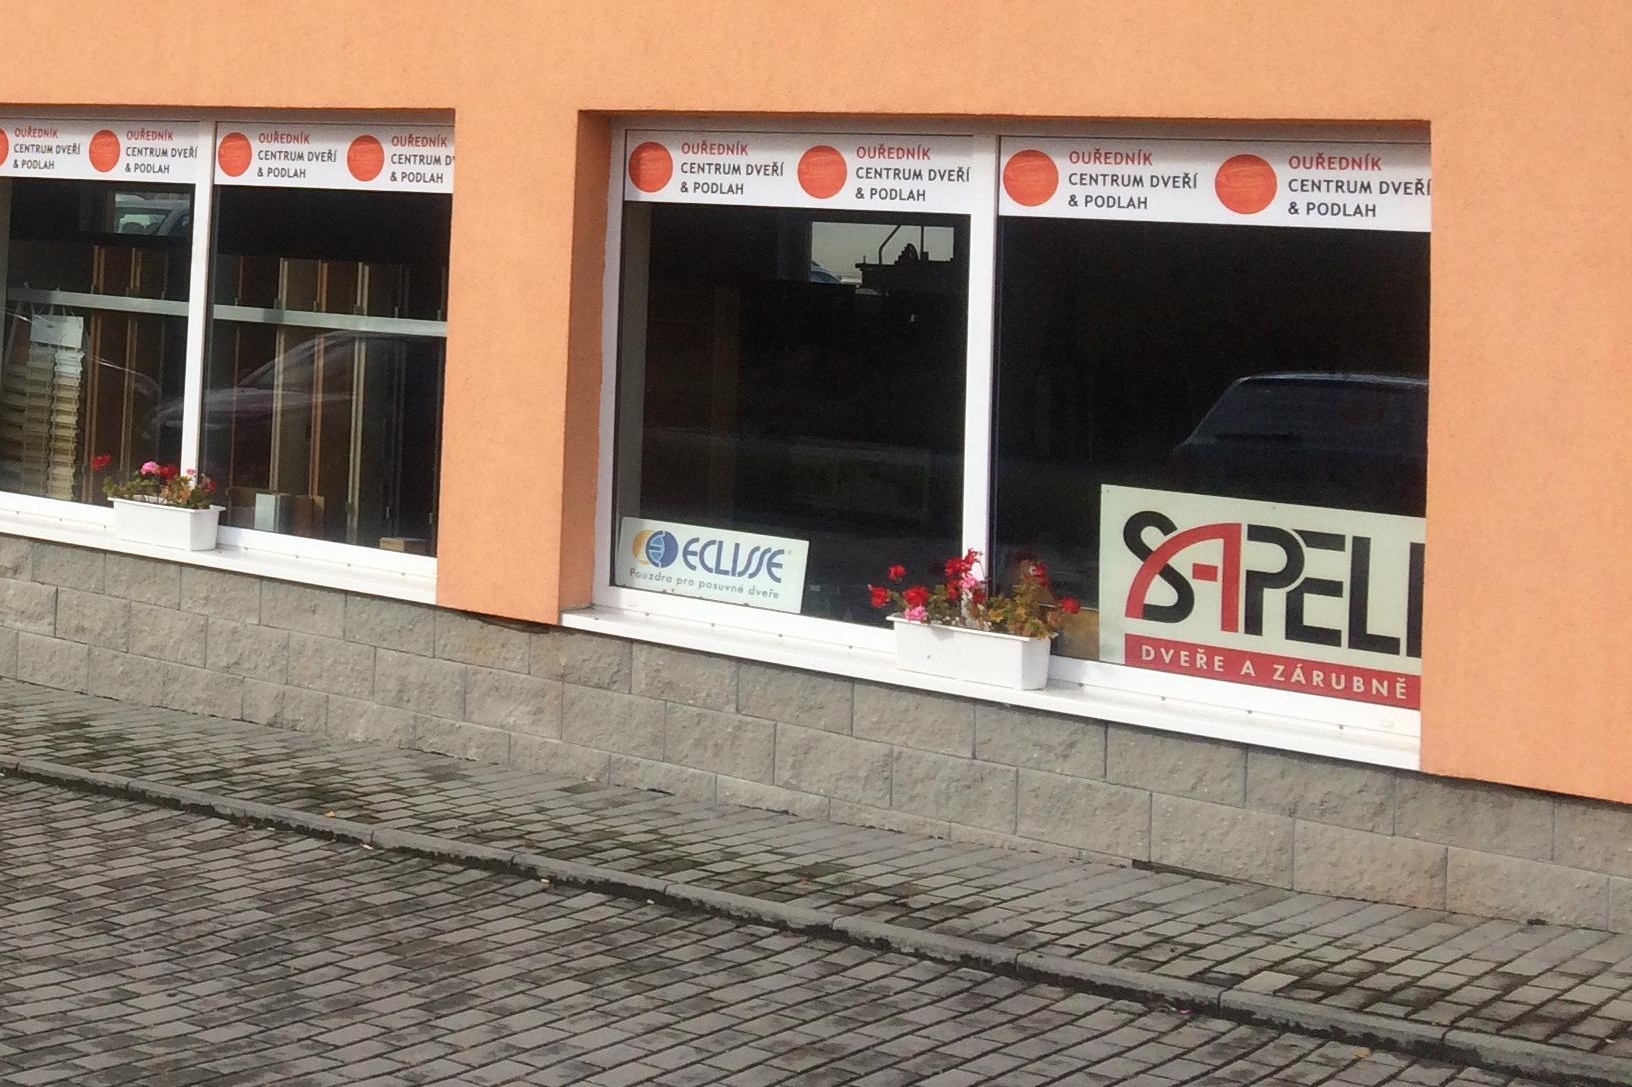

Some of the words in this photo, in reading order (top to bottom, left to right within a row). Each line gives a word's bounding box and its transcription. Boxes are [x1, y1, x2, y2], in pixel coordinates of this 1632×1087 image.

[13, 126, 59, 140] OUŘEDNÍK
[126, 127, 174, 142] OUŘEDNÍK
[258, 130, 311, 146] OUŘEDNÍK
[391, 132, 448, 150] OUŘEDNÍK
[13, 142, 54, 155] CENTRUM
[55, 142, 81, 156] DVEŘÍ
[125, 146, 168, 158] CENTRUM
[170, 145, 198, 160] DVEŘÍ
[257, 149, 305, 163] CENTRUM
[307, 148, 337, 164] DVEŘÍ
[680, 140, 748, 156] OUŘEDNÍK
[856, 144, 931, 161] OUŘEDNÍK
[13, 159, 19, 169] &
[21, 159, 55, 170] PODLAH
[390, 153, 441, 166] CENTRUM
[1068, 148, 1153, 167] OUŘEDNÍK
[1288, 152, 1383, 172] OUŘEDNÍK
[125, 162, 132, 173] &
[134, 162, 170, 175] PODLAH
[256, 166, 264, 178] &
[266, 167, 306, 179] PODLAH
[680, 162, 742, 175] CENTRUM
[745, 161, 785, 177] DVEŘÍ
[856, 166, 924, 181] CENTRUM
[927, 165, 970, 183] DVEŘÍ
[390, 171, 399, 183] &
[400, 171, 444, 184] PODLAH
[1068, 172, 1145, 188] CENTRUM
[1149, 171, 1198, 190] DVEŘÍ
[680, 181, 689, 194] &
[693, 182, 745, 195] PODLAH
[855, 187, 865, 200] &
[869, 188, 926, 202] PODLAH
[1287, 177, 1373, 194] CENTRUM
[1378, 177, 1431, 196] DVEŘÍ
[1067, 194, 1079, 208] &
[1084, 194, 1148, 210] PODLAH
[1287, 201, 1299, 216] &
[1306, 201, 1377, 218] PODLAH
[682, 536, 785, 584] ECLISSE
[676, 575, 694, 589] pro
[698, 580, 744, 594] posuvné
[748, 585, 780, 600] dveře
[1140, 644, 1224, 673] DVEŘE
[1240, 660, 1256, 677] A
[1272, 663, 1408, 700] ZÁRUBNĚ
